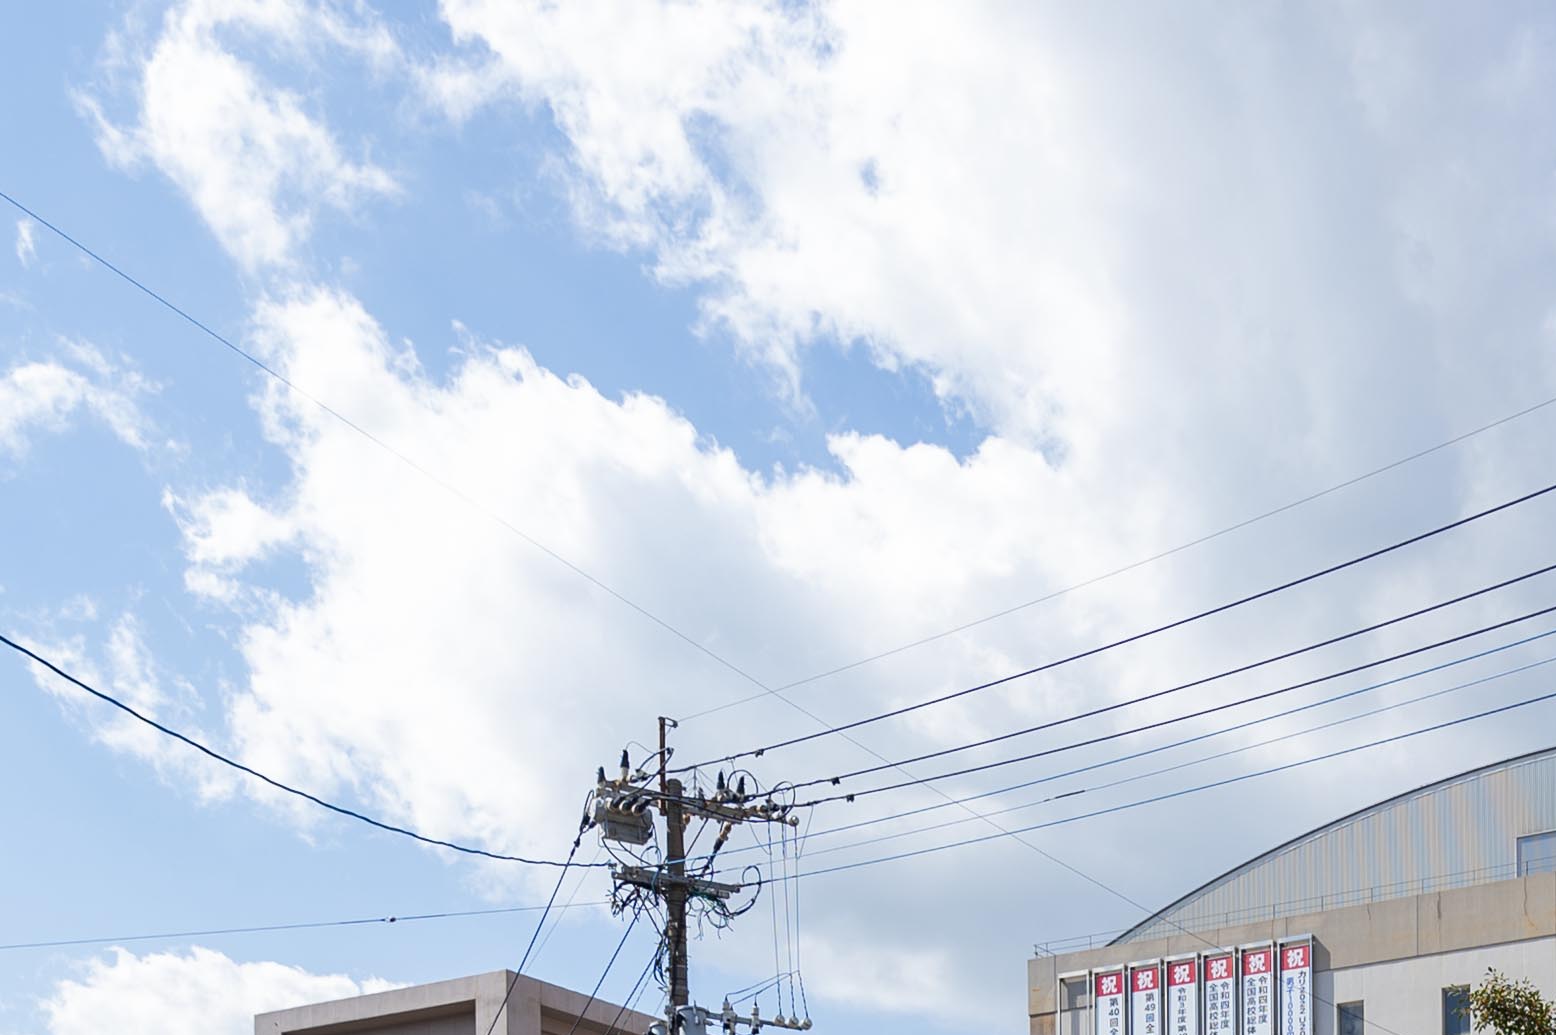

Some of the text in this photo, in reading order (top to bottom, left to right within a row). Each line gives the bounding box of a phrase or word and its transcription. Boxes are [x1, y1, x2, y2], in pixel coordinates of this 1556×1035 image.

[1249, 954, 1266, 973] 祝
[1287, 948, 1304, 967] 祝
[1174, 965, 1190, 984] 祝
[1211, 960, 1227, 979] 祝
[1101, 976, 1118, 994] 祝
[1137, 971, 1153, 990] 祝
